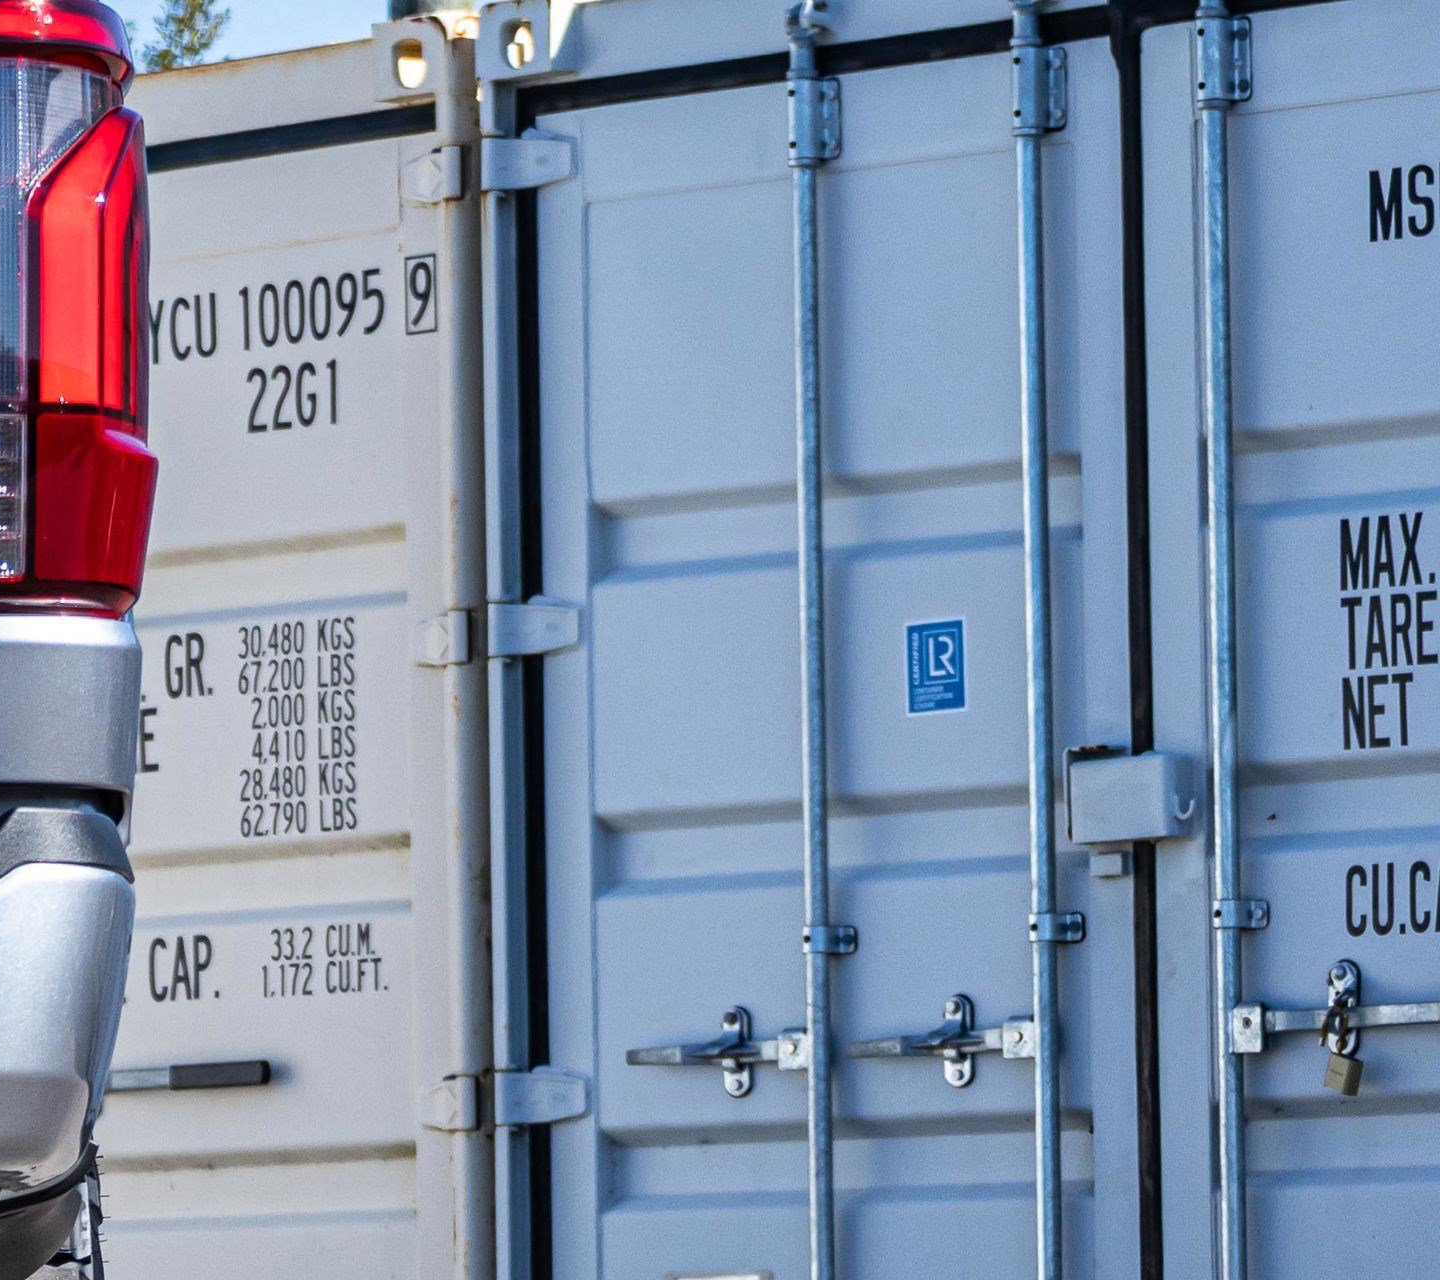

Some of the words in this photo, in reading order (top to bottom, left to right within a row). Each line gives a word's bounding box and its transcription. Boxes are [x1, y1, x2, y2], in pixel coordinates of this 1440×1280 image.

[1368, 162, 1440, 242] MS
[238, 268, 385, 351] 100095
[407, 259, 433, 329] 9
[246, 358, 337, 434] 22G1
[1340, 511, 1436, 591] MAX.
[165, 632, 213, 699] GR.
[317, 617, 355, 652] KGS
[1340, 590, 1439, 670] TARE
[317, 653, 355, 688] LBS
[318, 689, 356, 724] KGS
[318, 725, 356, 760] LBS
[1342, 672, 1414, 751] NET
[319, 761, 357, 796] KGS
[320, 797, 358, 832] LBS
[1345, 860, 1440, 938] CU.C
[149, 934, 220, 1003] CAP.
[270, 927, 313, 961] 33.2
[325, 923, 376, 958] CU.M.
[325, 957, 388, 994] CU.FT.
